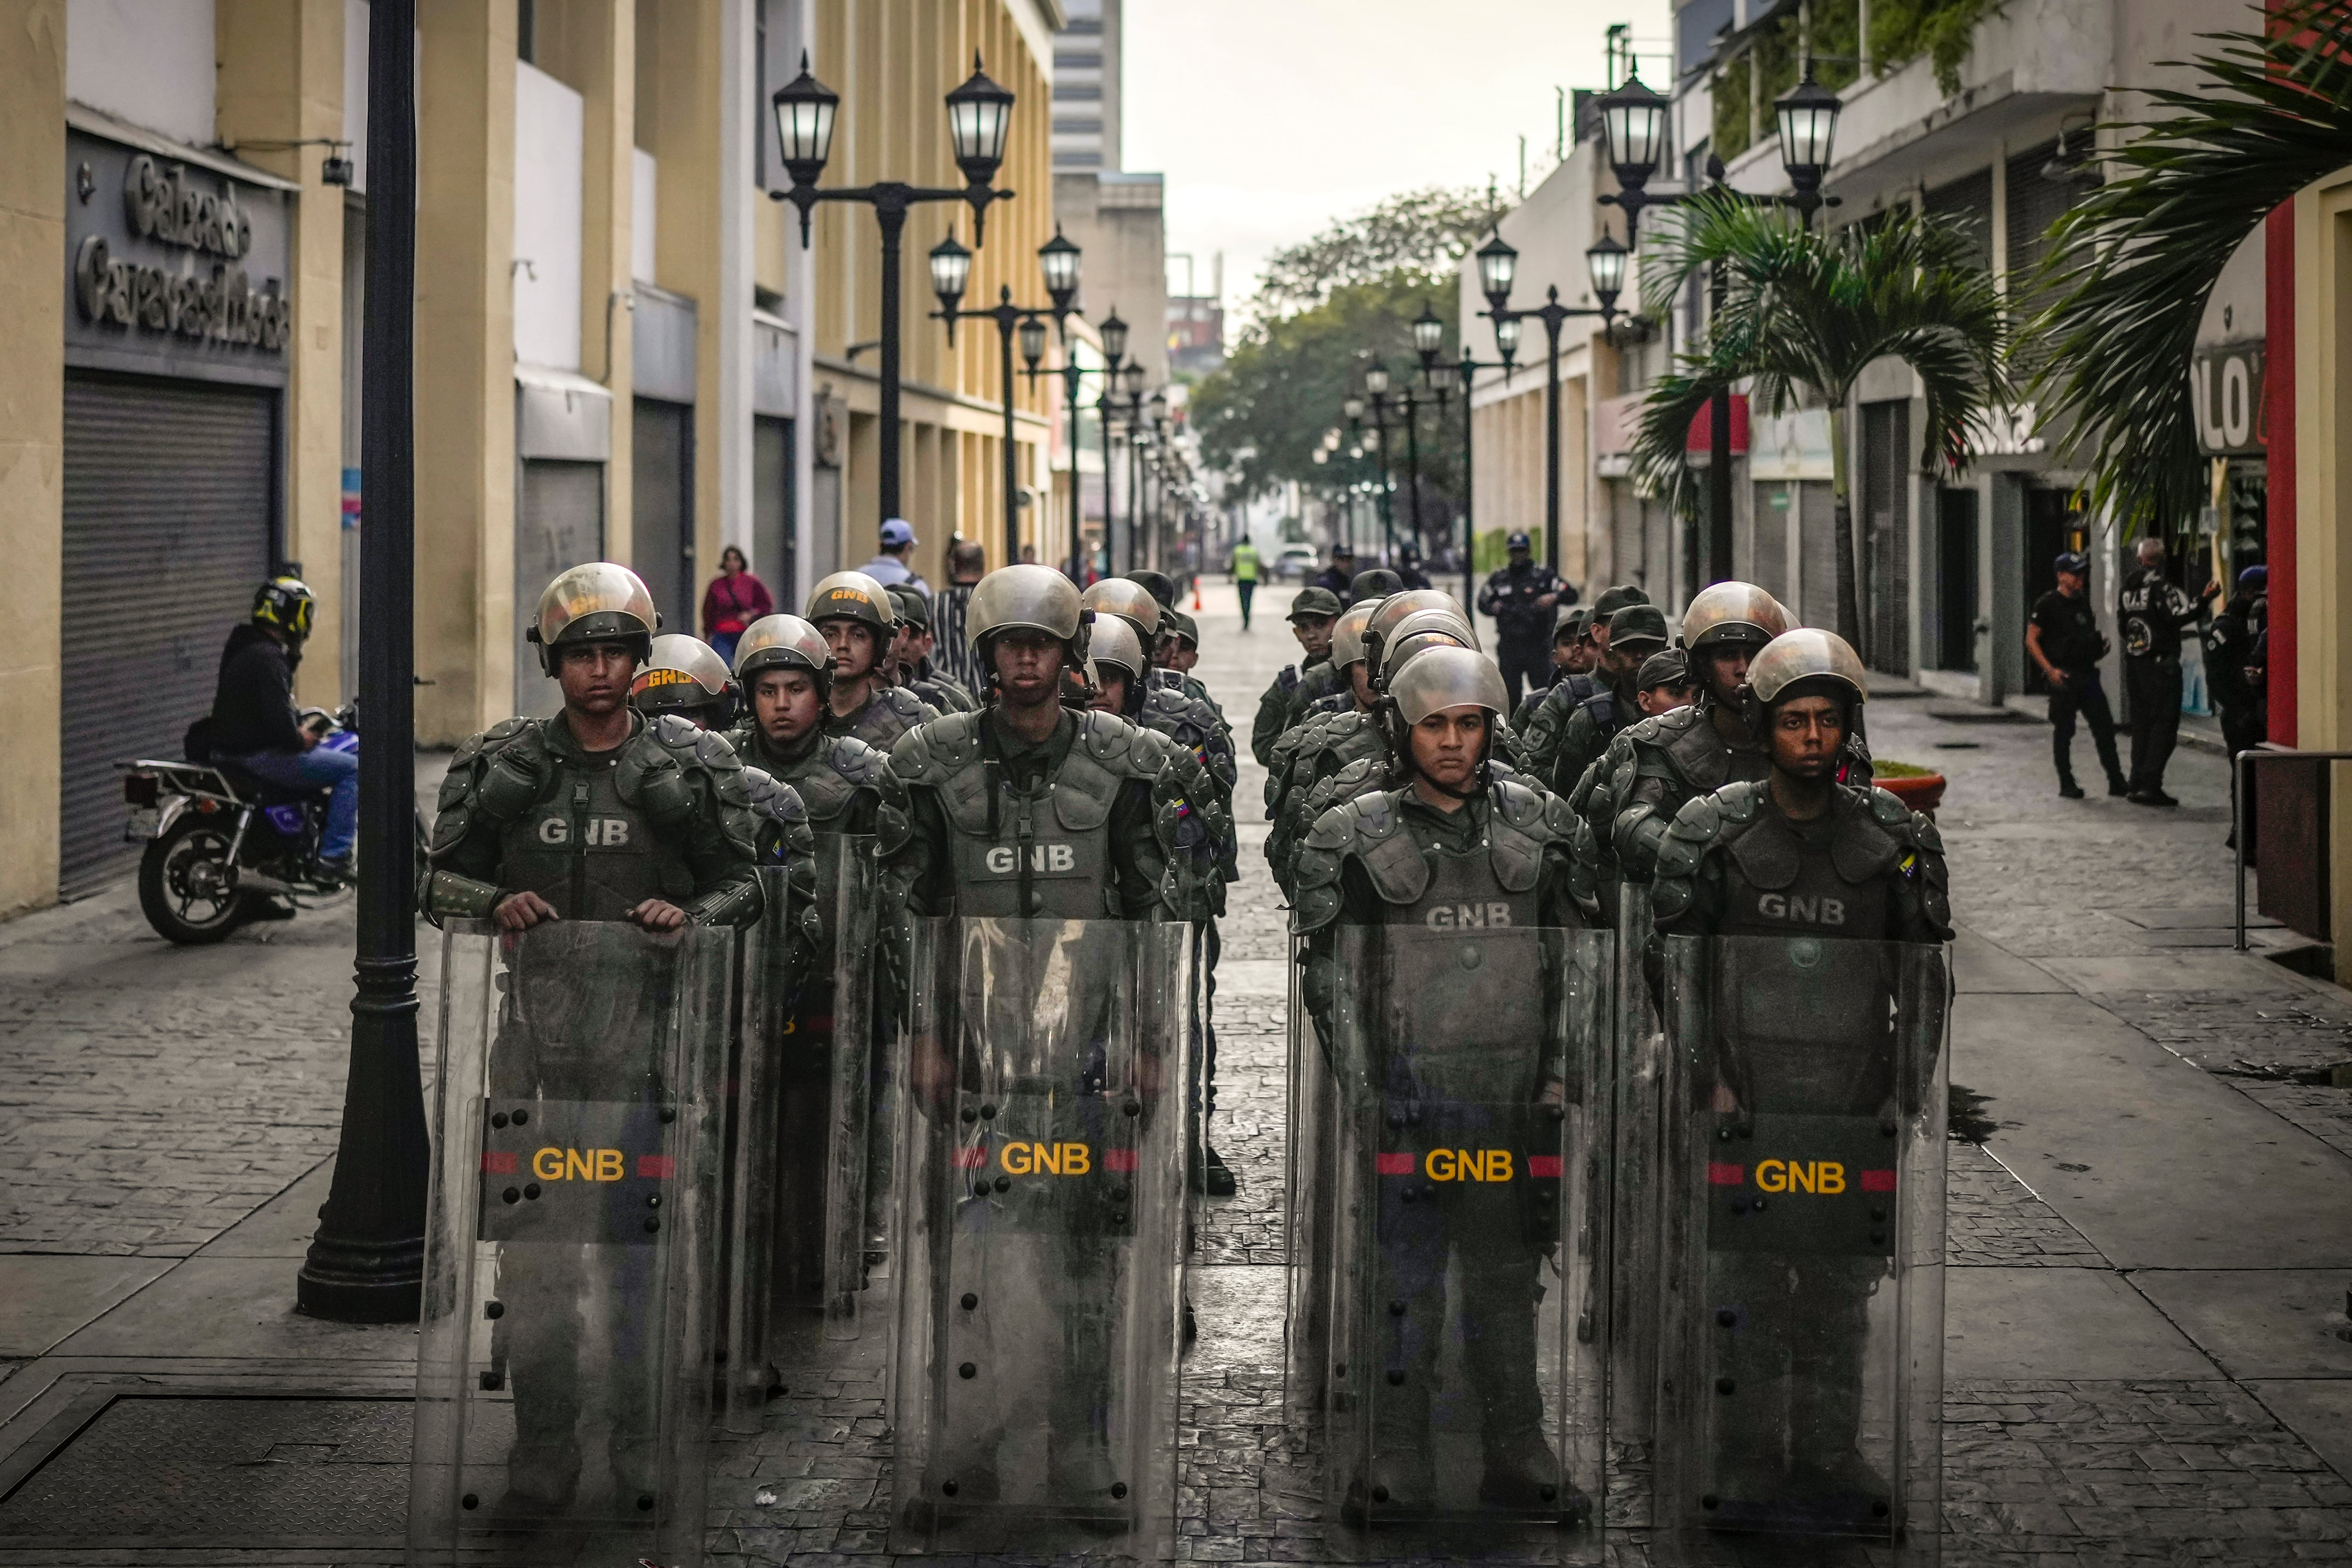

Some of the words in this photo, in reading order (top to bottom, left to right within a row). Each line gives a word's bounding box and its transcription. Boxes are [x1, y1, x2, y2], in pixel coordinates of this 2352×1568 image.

[831, 590, 868, 604] GNB
[648, 669, 692, 687] GNB
[1427, 902, 1512, 931] GNB
[1758, 893, 1845, 925] GNB
[532, 1147, 625, 1182] GNB
[1001, 1141, 1091, 1175] GNB
[1425, 1148, 1514, 1182] GNB
[1755, 1159, 1847, 1194] GNB
